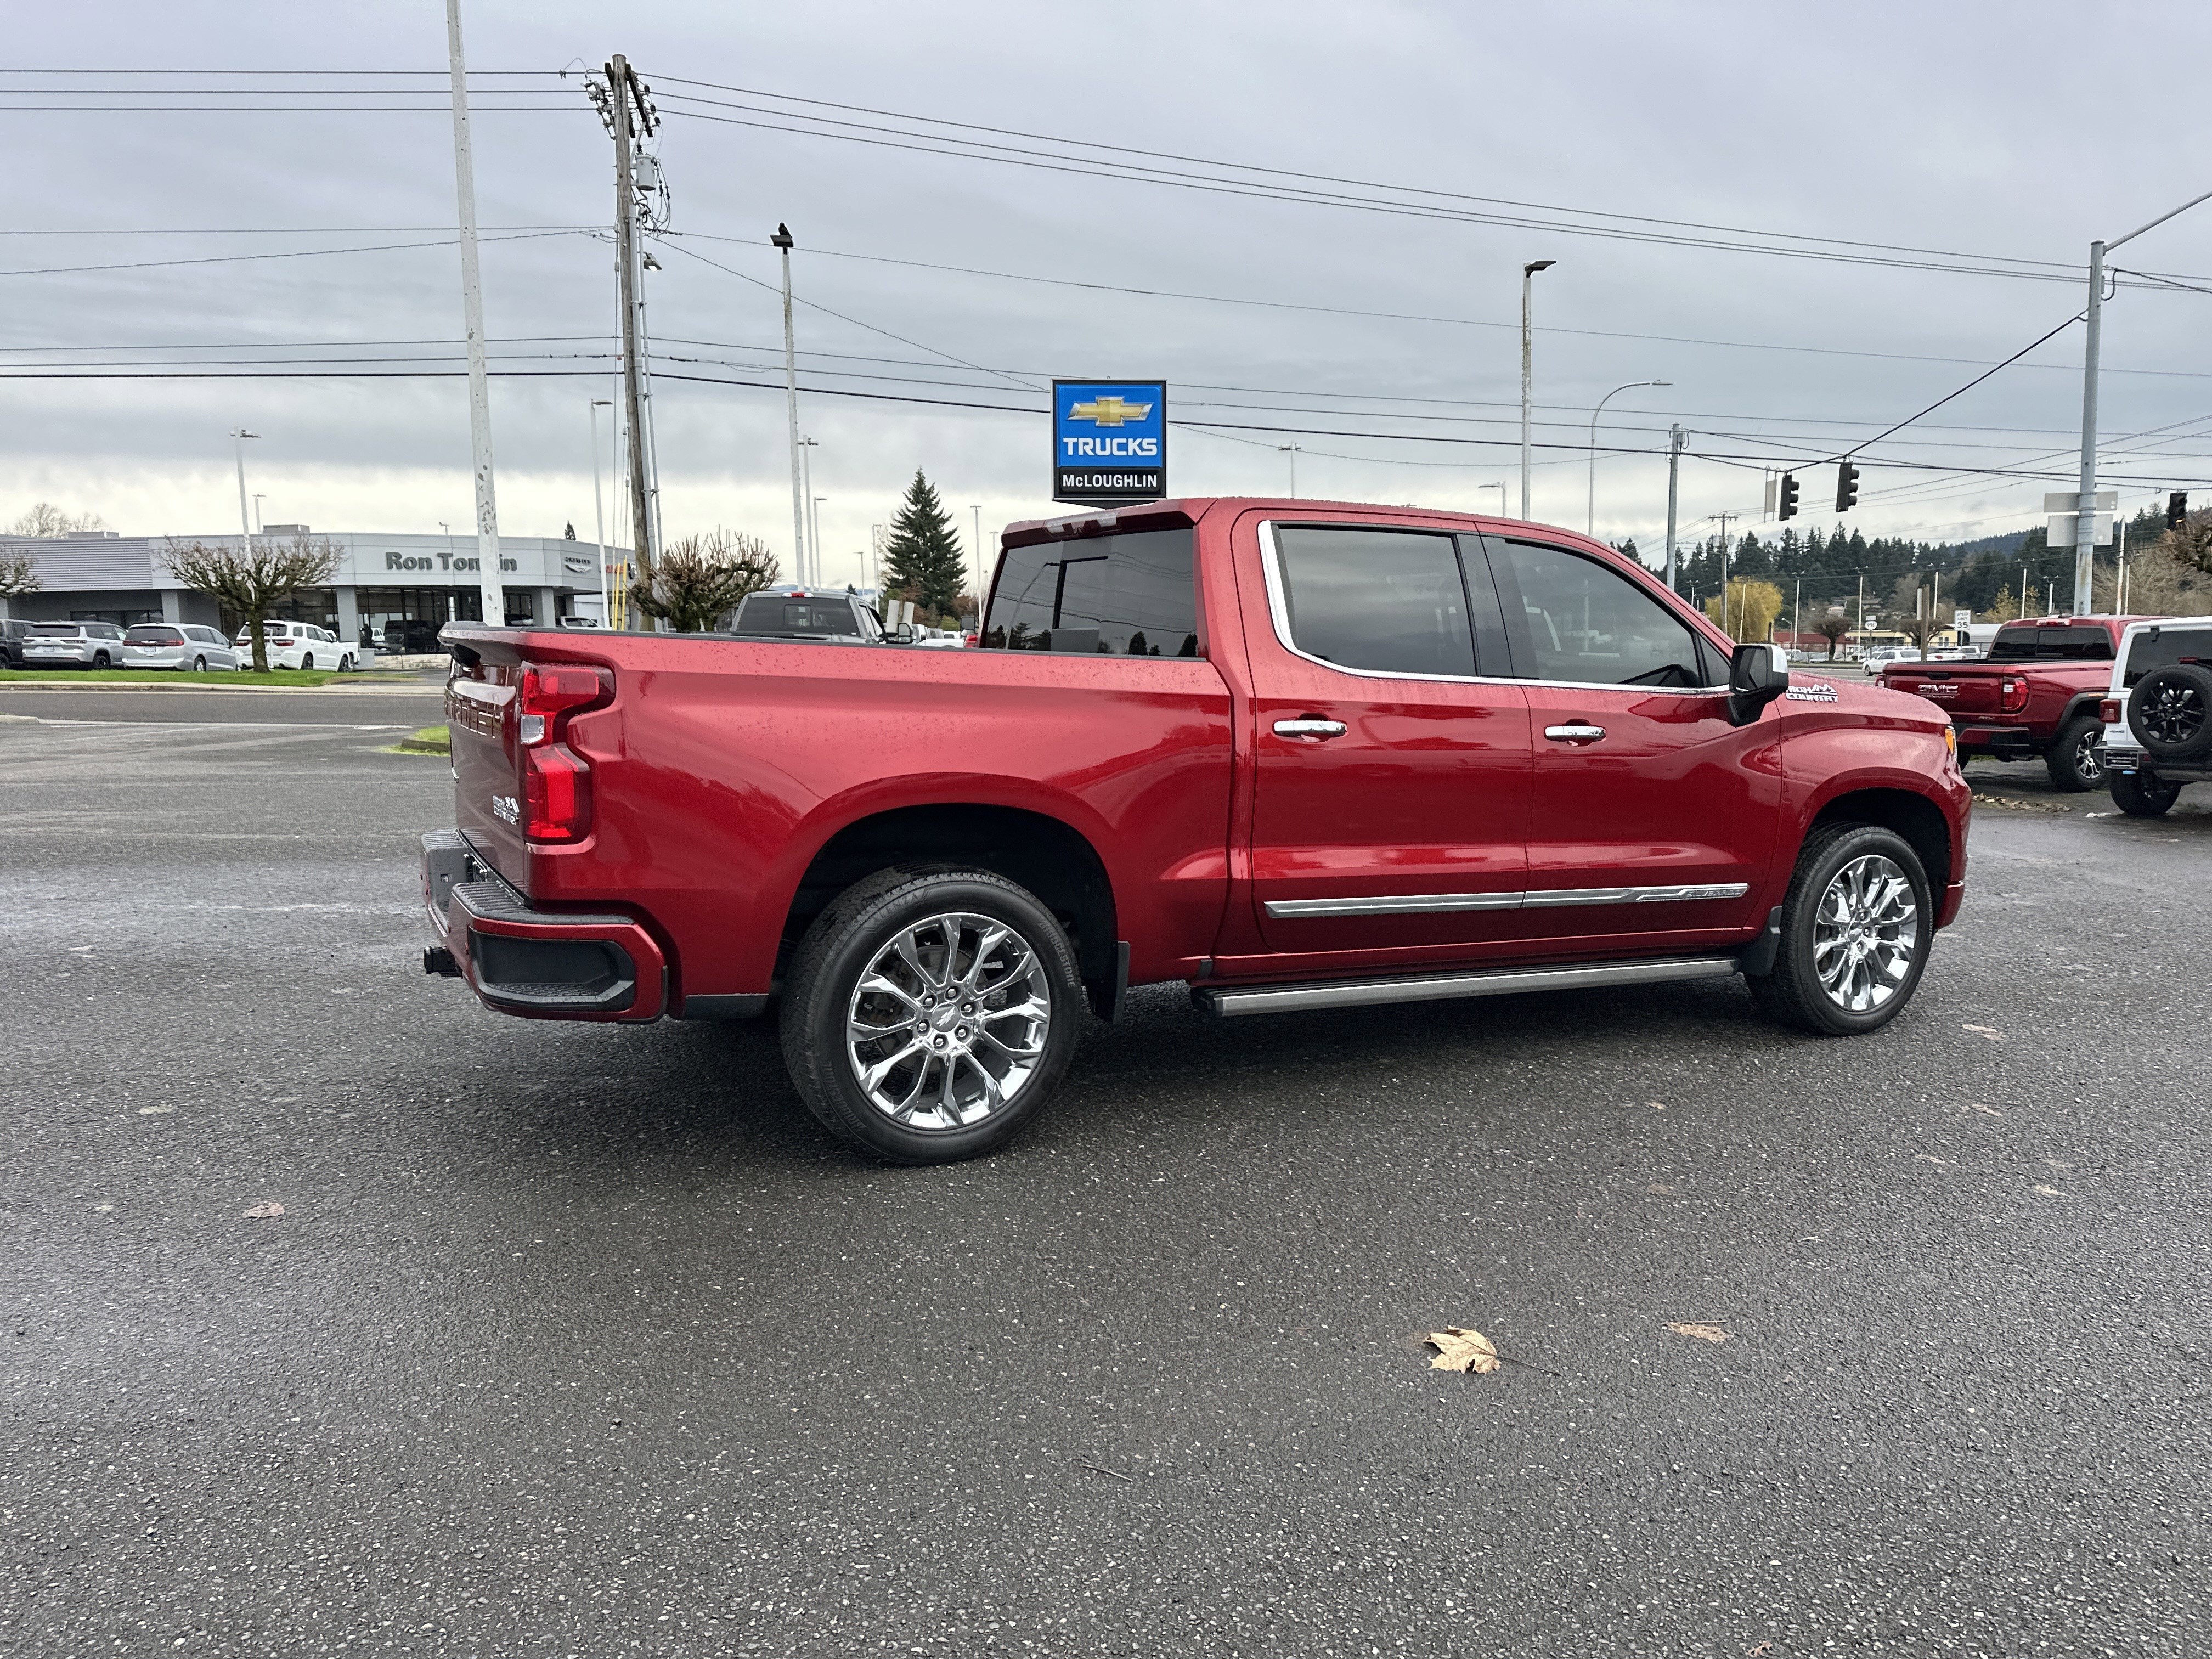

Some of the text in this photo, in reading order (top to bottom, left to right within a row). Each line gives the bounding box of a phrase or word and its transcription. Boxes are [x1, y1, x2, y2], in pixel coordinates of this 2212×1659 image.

[1063, 437, 1158, 456] TRUCKS
[1063, 474, 1157, 488] McLOUGHLIN
[386, 551, 517, 572] Ron Tonin
[1918, 684, 1959, 693] GMC
[1785, 693, 1838, 703] COUNTRY
